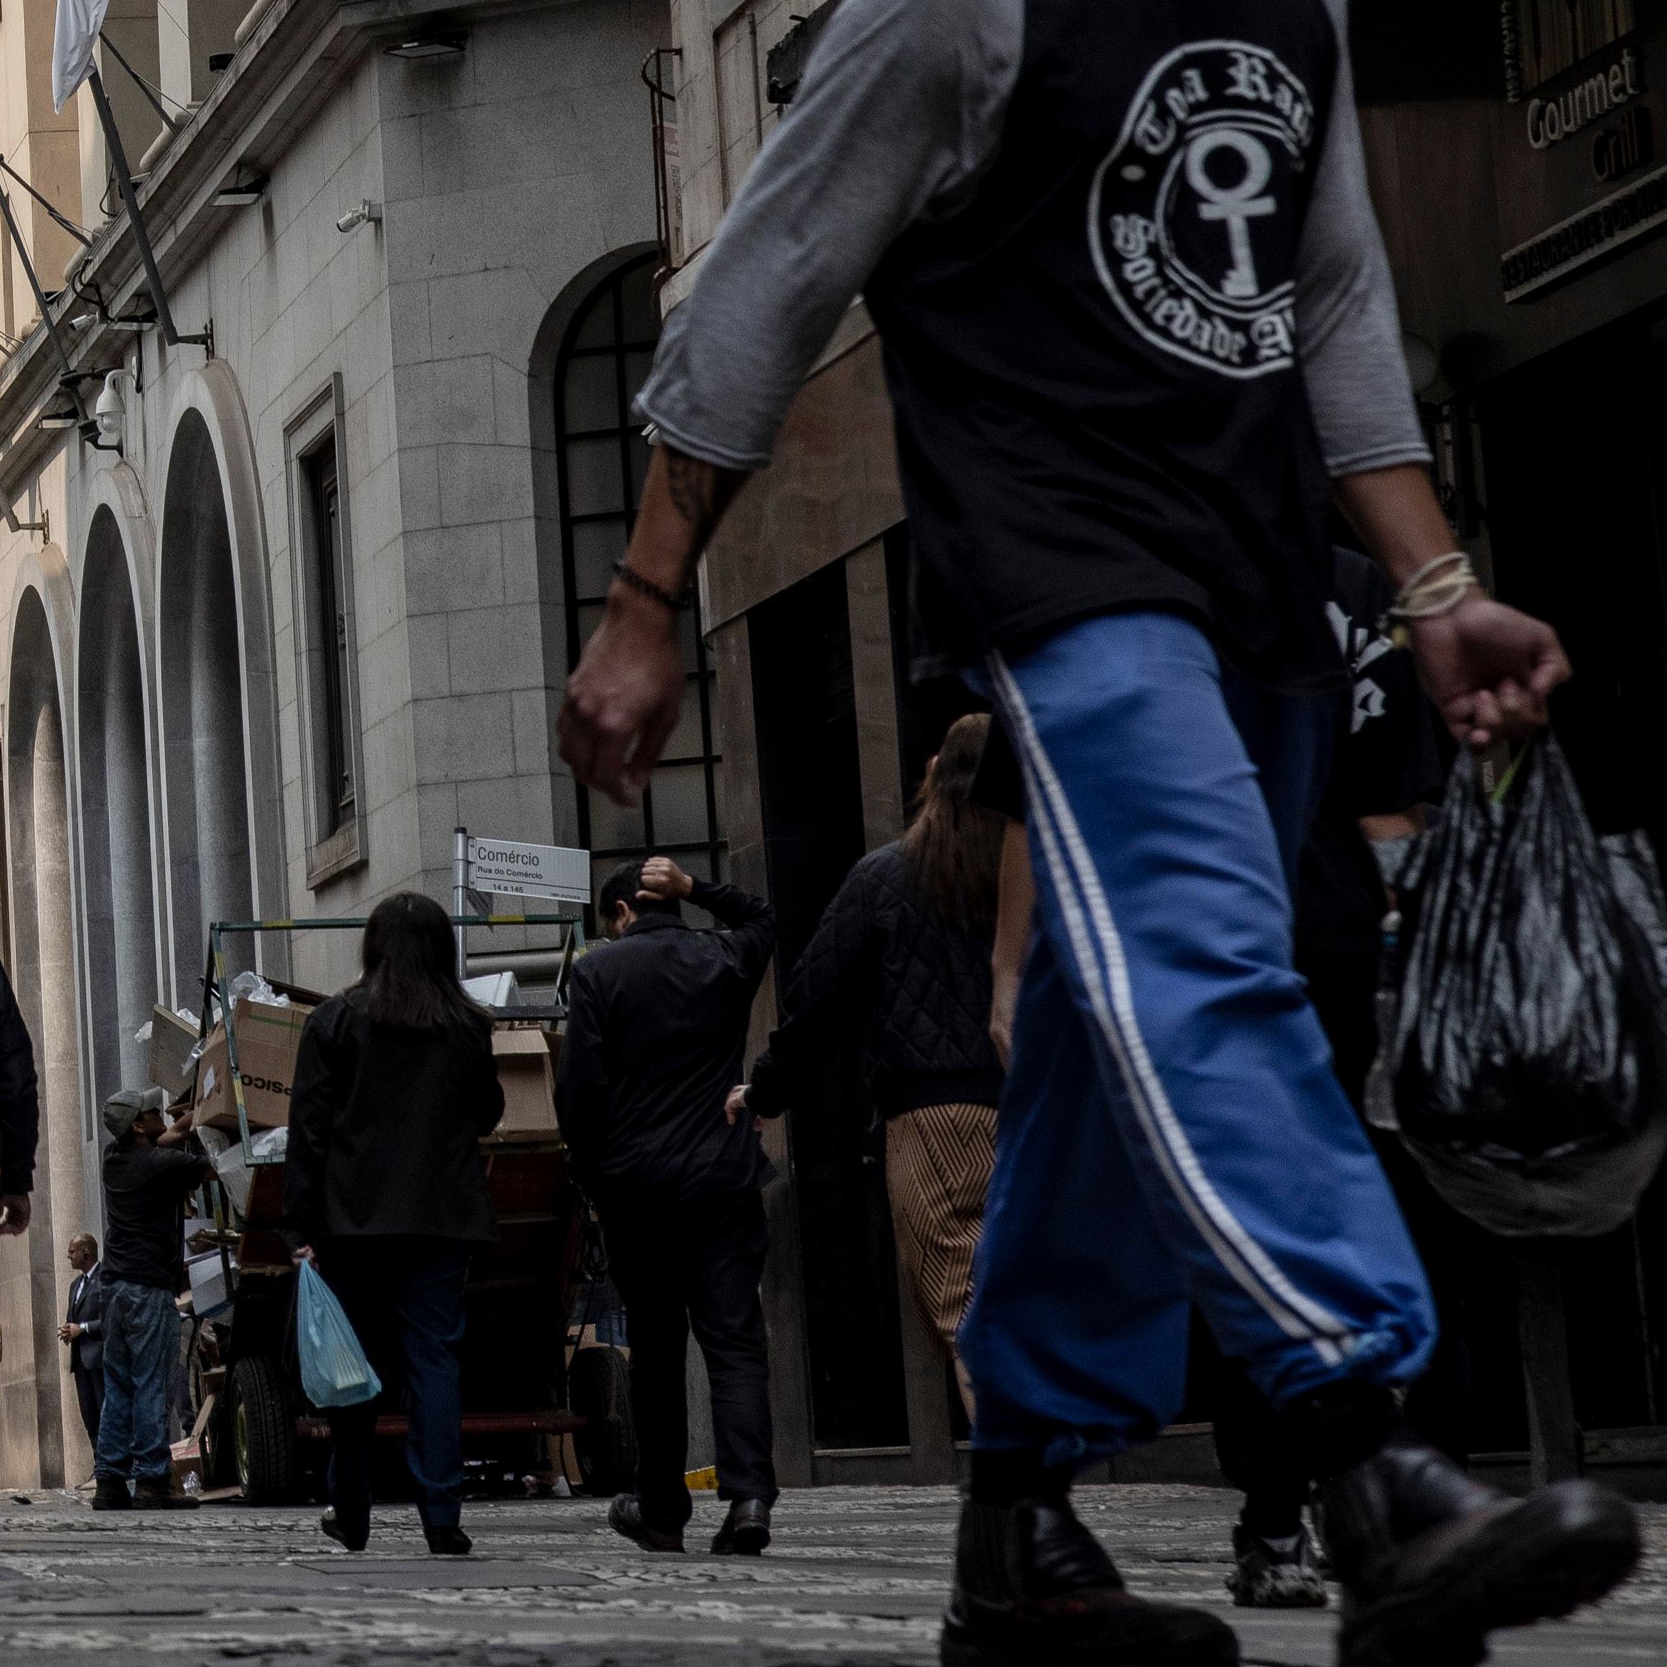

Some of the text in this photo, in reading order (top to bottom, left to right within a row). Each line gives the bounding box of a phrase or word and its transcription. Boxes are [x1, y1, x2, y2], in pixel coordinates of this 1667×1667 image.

[1527, 46, 1641, 150] Gourmet
[477, 846, 540, 867] Comércio
[477, 865, 493, 875] Rua
[506, 868, 543, 880] Comércio
